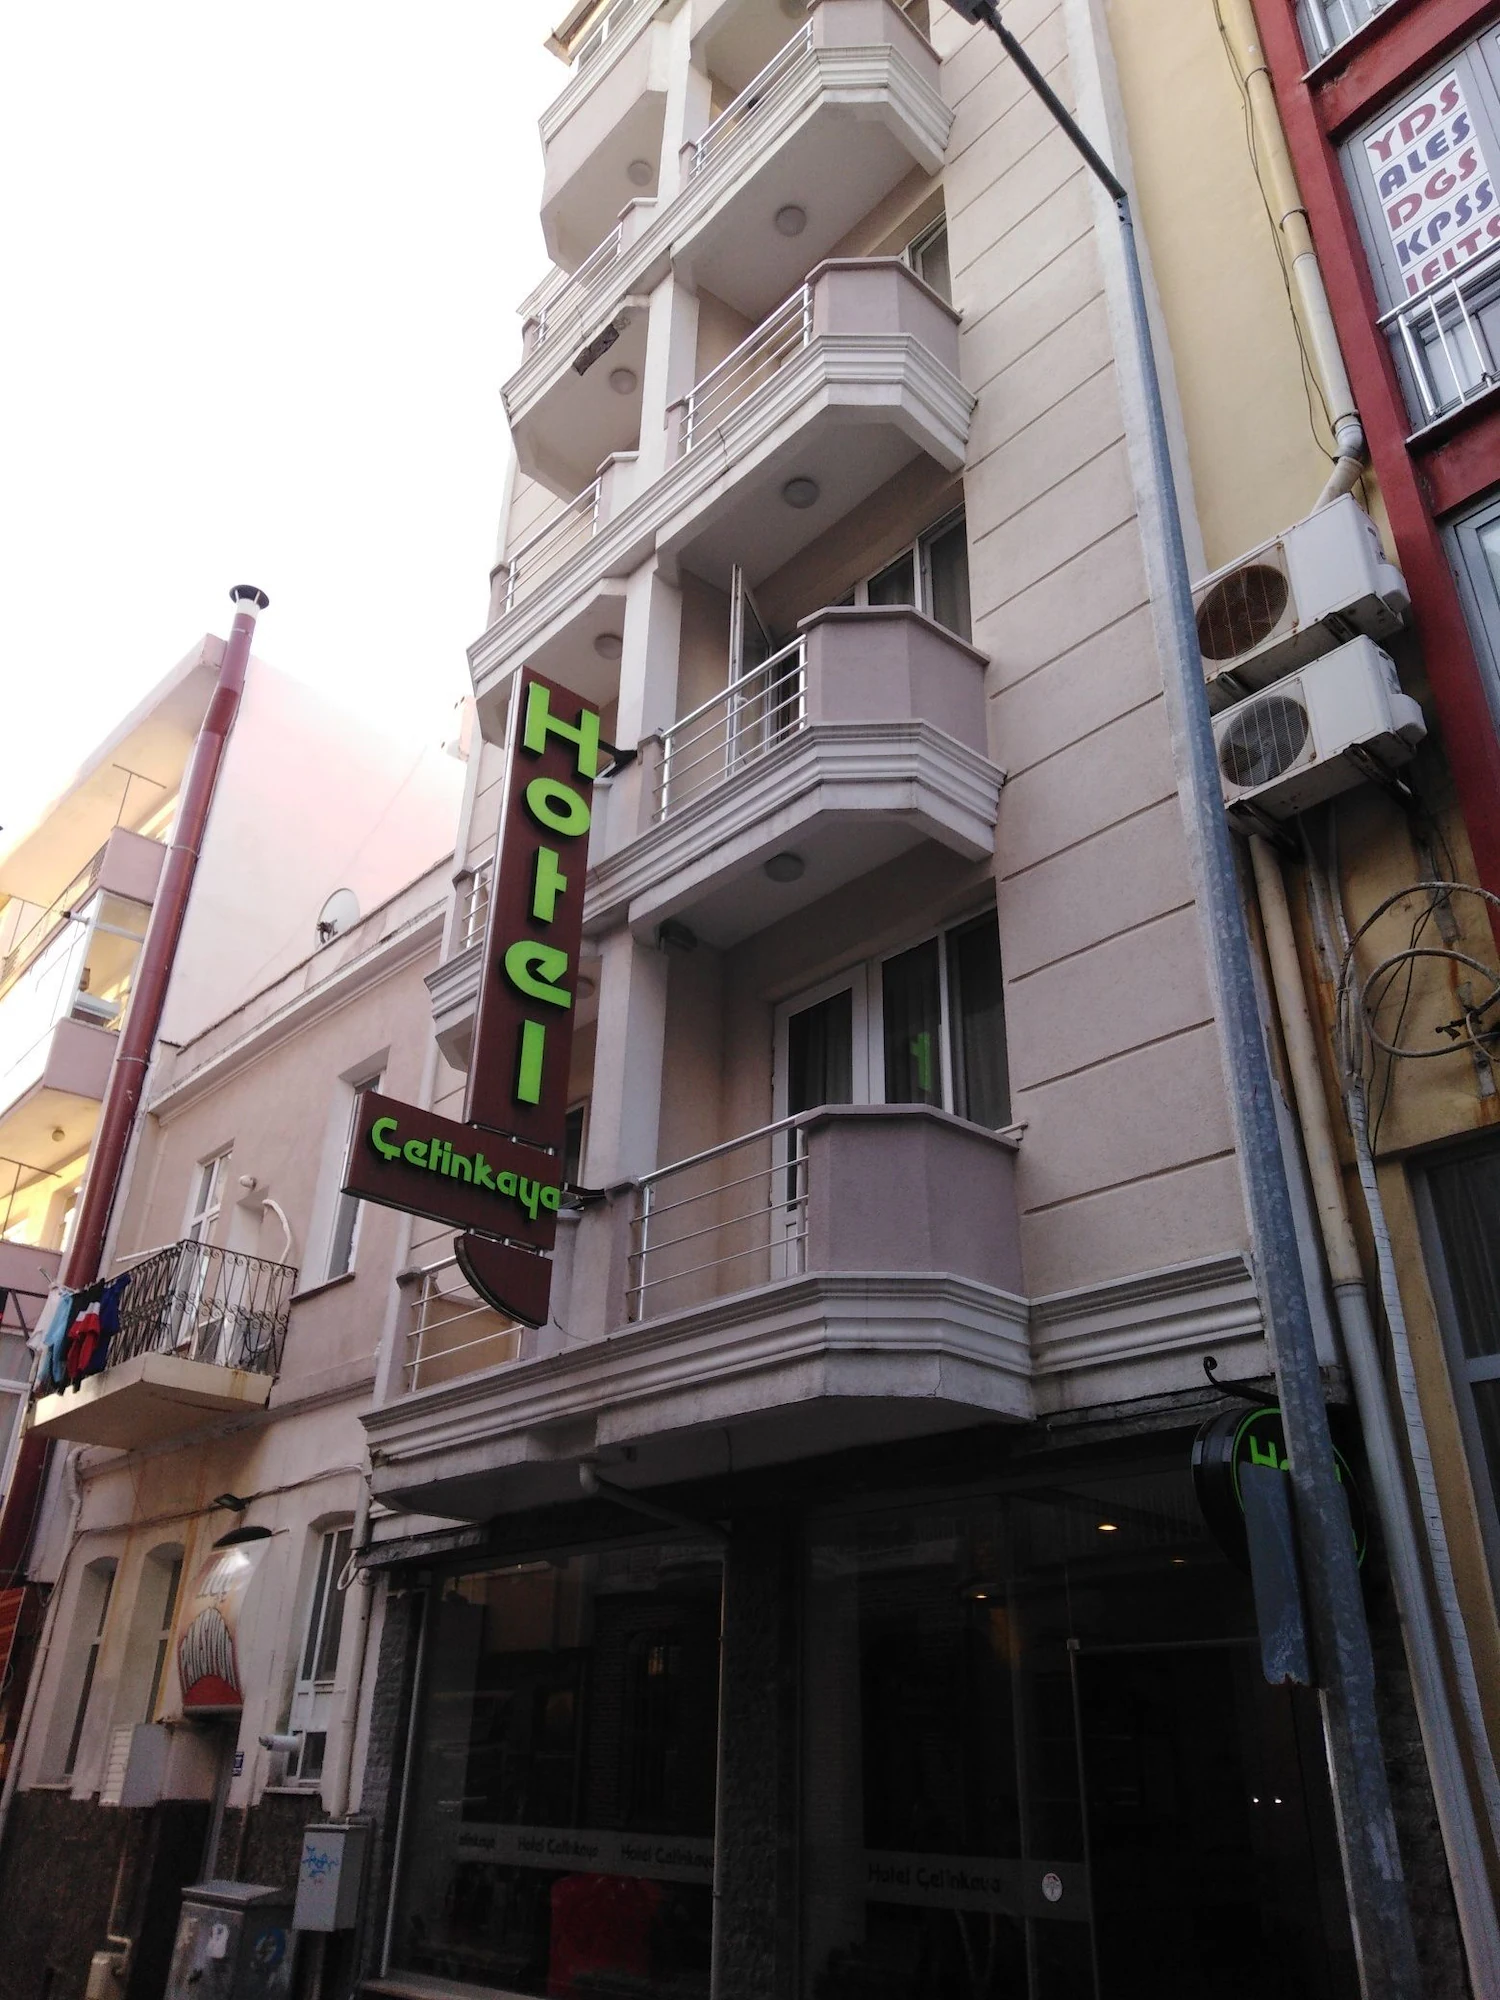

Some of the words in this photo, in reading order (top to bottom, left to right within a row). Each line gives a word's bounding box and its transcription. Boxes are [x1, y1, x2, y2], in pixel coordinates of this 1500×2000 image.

[1366, 79, 1460, 163] YDS
[1379, 111, 1471, 200] ALES
[1386, 146, 1478, 232] DGS
[1396, 178, 1494, 268] KPSS
[502, 680, 600, 1105] Hotel
[371, 1116, 562, 1221] Çetinkaya
